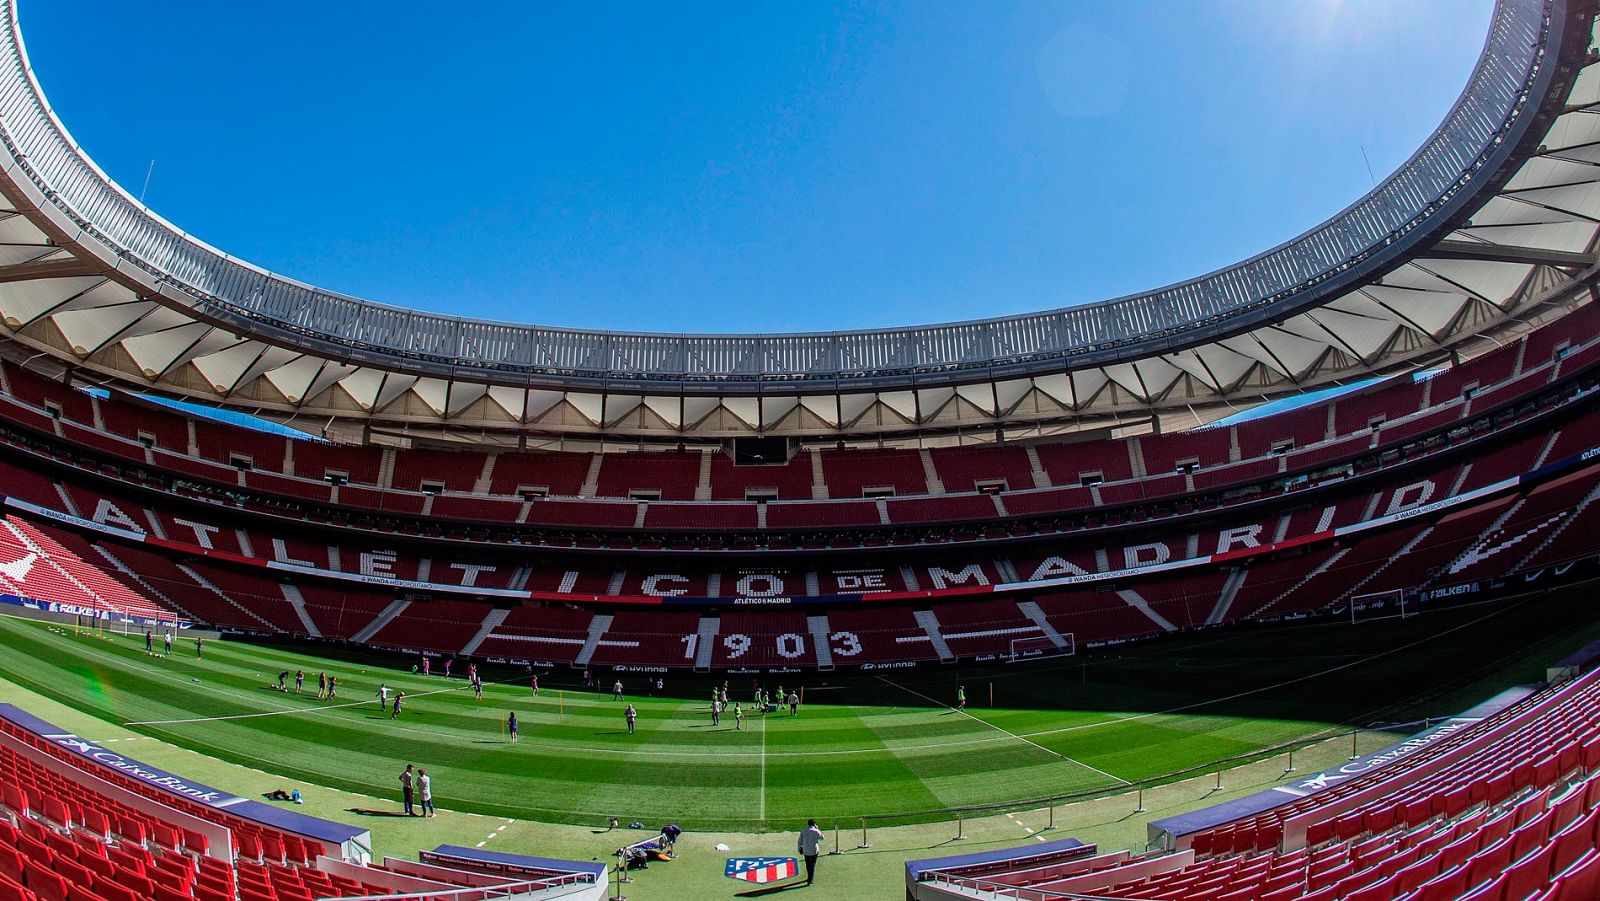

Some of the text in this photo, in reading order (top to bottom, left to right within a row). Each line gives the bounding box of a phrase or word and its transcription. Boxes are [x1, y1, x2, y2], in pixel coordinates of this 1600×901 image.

[46, 510, 66, 521] WANDA
[1400, 508, 1422, 518] WANDA
[367, 577, 389, 585] WANDA
[1074, 574, 1096, 582] WANDA
[681, 632, 863, 659] 1903
[877, 661, 916, 669] HYUNDAI
[1339, 722, 1467, 775] CaixaBank
[93, 752, 219, 801] CaixaBank
